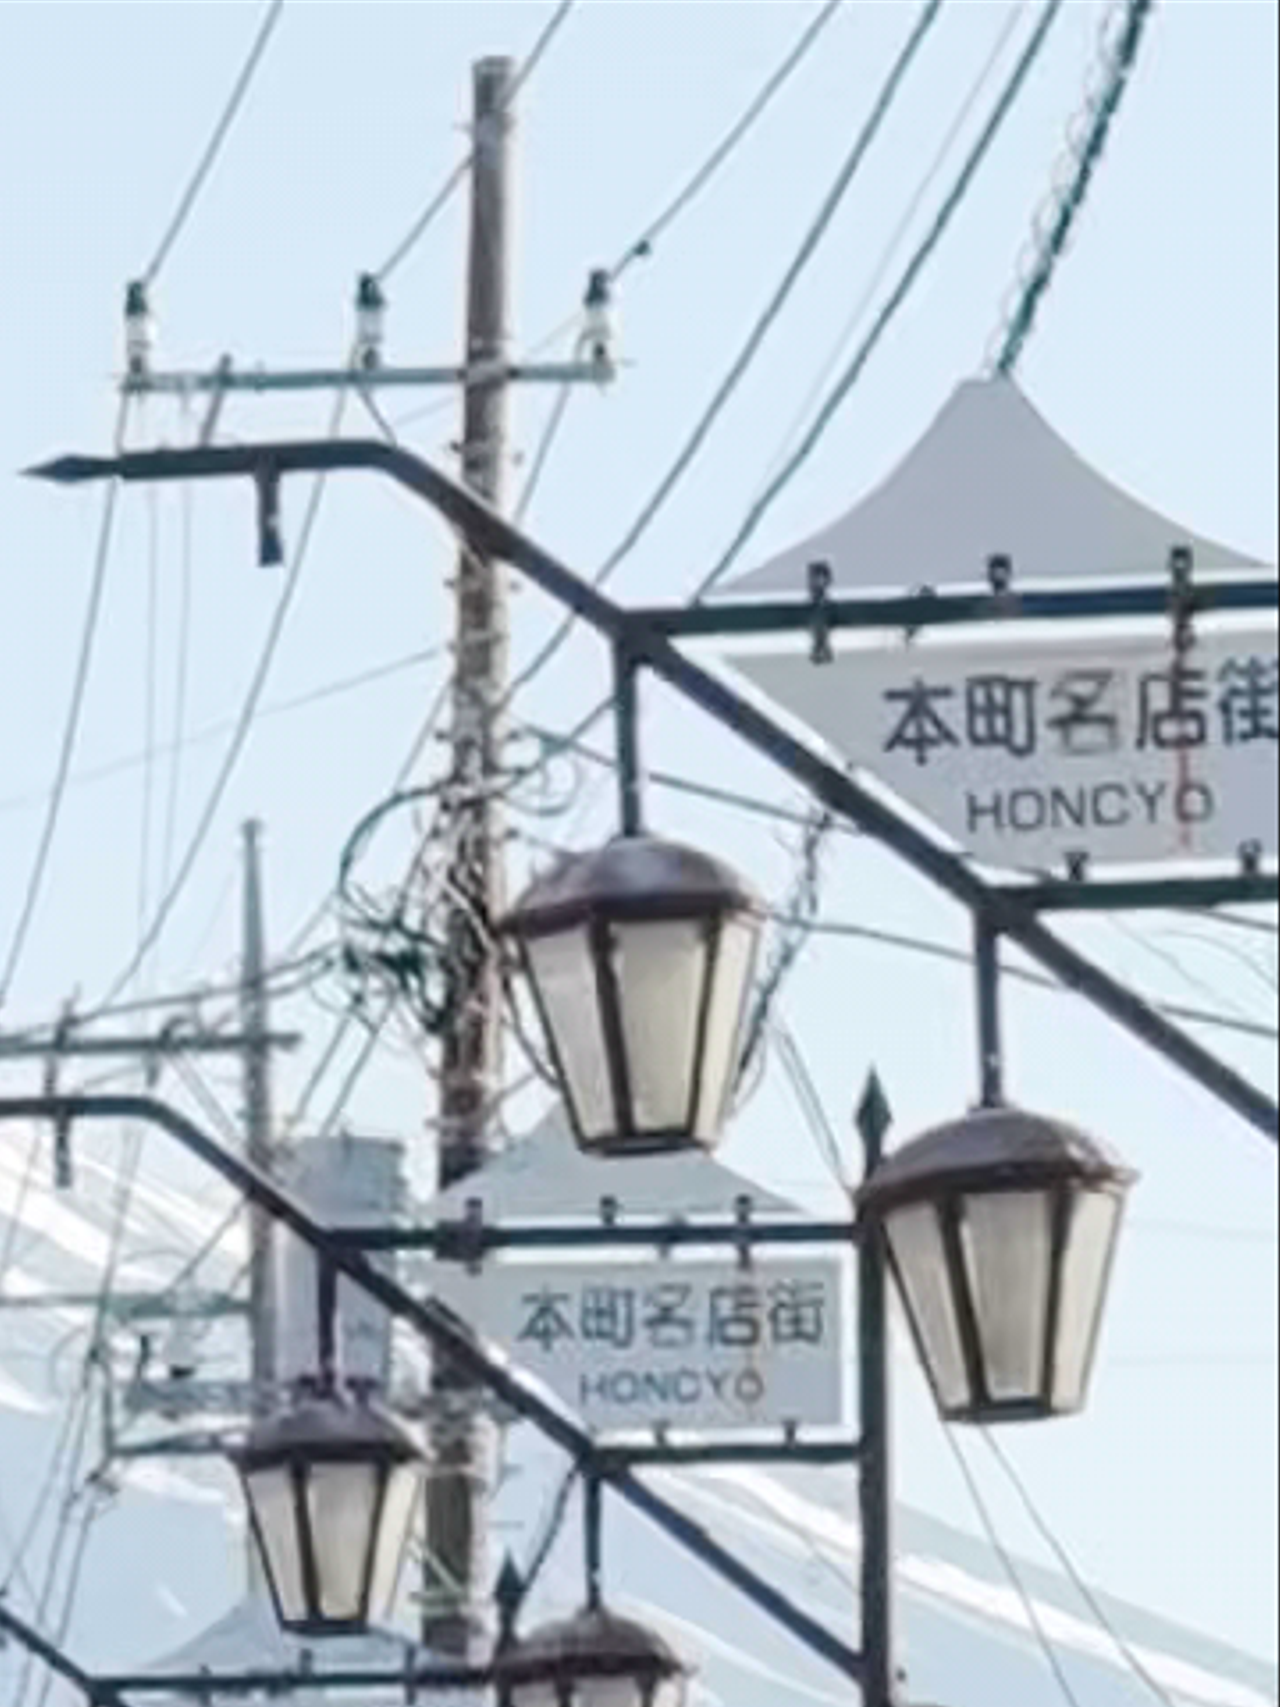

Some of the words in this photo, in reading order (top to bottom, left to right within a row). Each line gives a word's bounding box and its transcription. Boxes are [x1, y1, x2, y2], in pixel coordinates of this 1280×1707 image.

[965, 780, 1216, 834] HONCYO
[516, 1280, 826, 1352] 本町名店街
[579, 1366, 765, 1405] HONCYO
